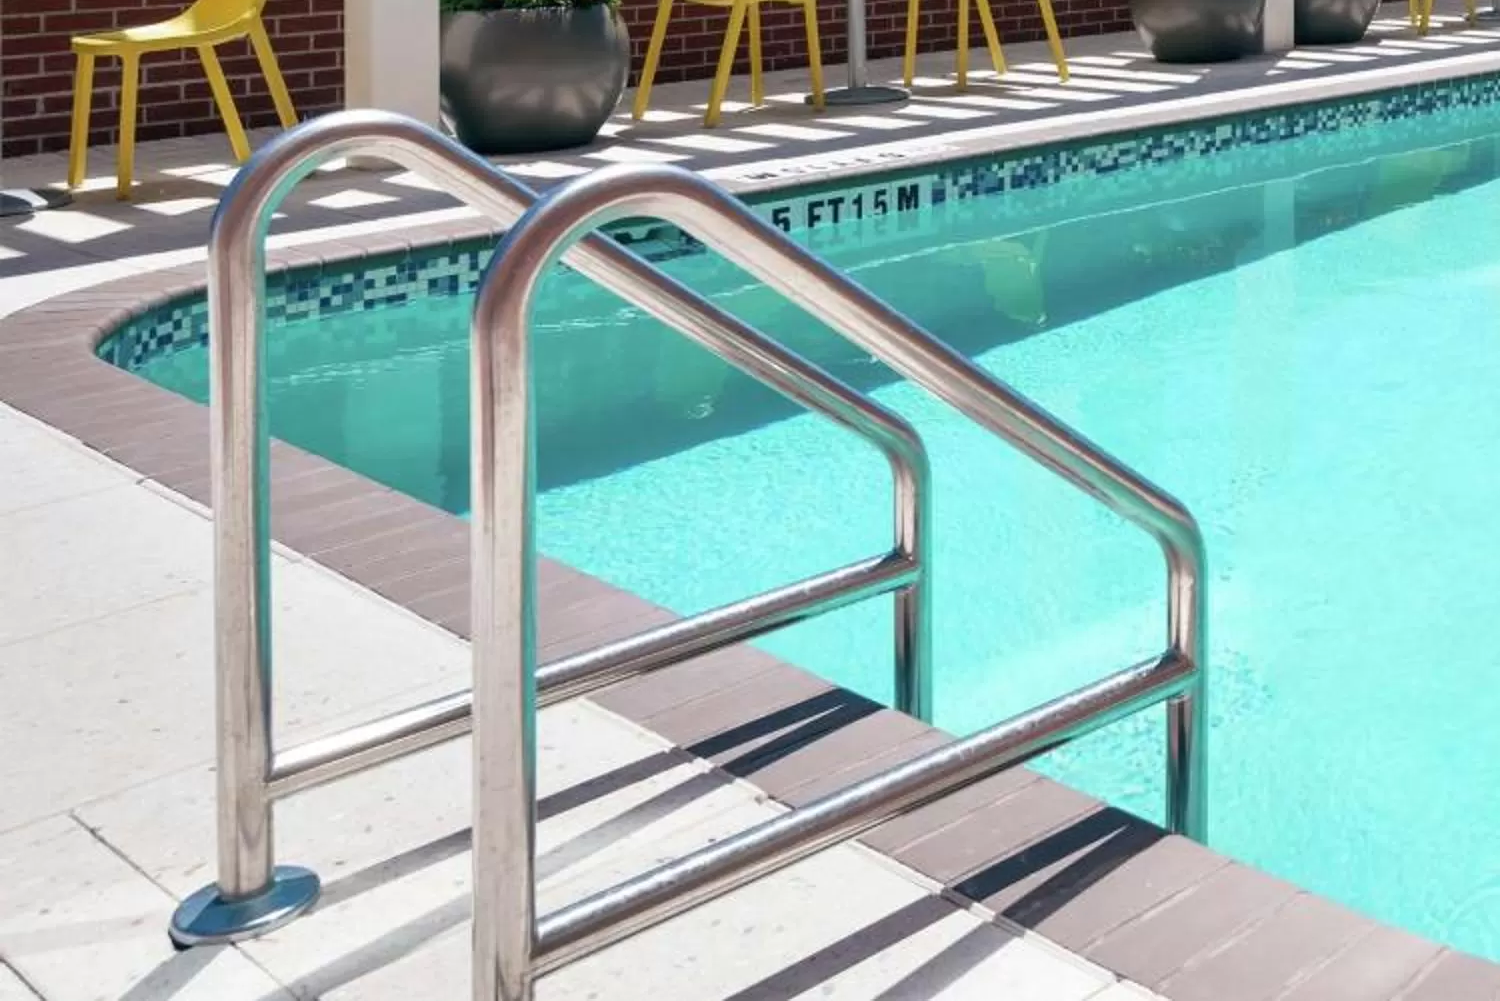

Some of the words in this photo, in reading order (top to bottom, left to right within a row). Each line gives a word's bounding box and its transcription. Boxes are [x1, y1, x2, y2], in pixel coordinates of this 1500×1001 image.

[772, 206, 791, 232] 5
[807, 196, 845, 228] FT
[897, 183, 919, 212] M
